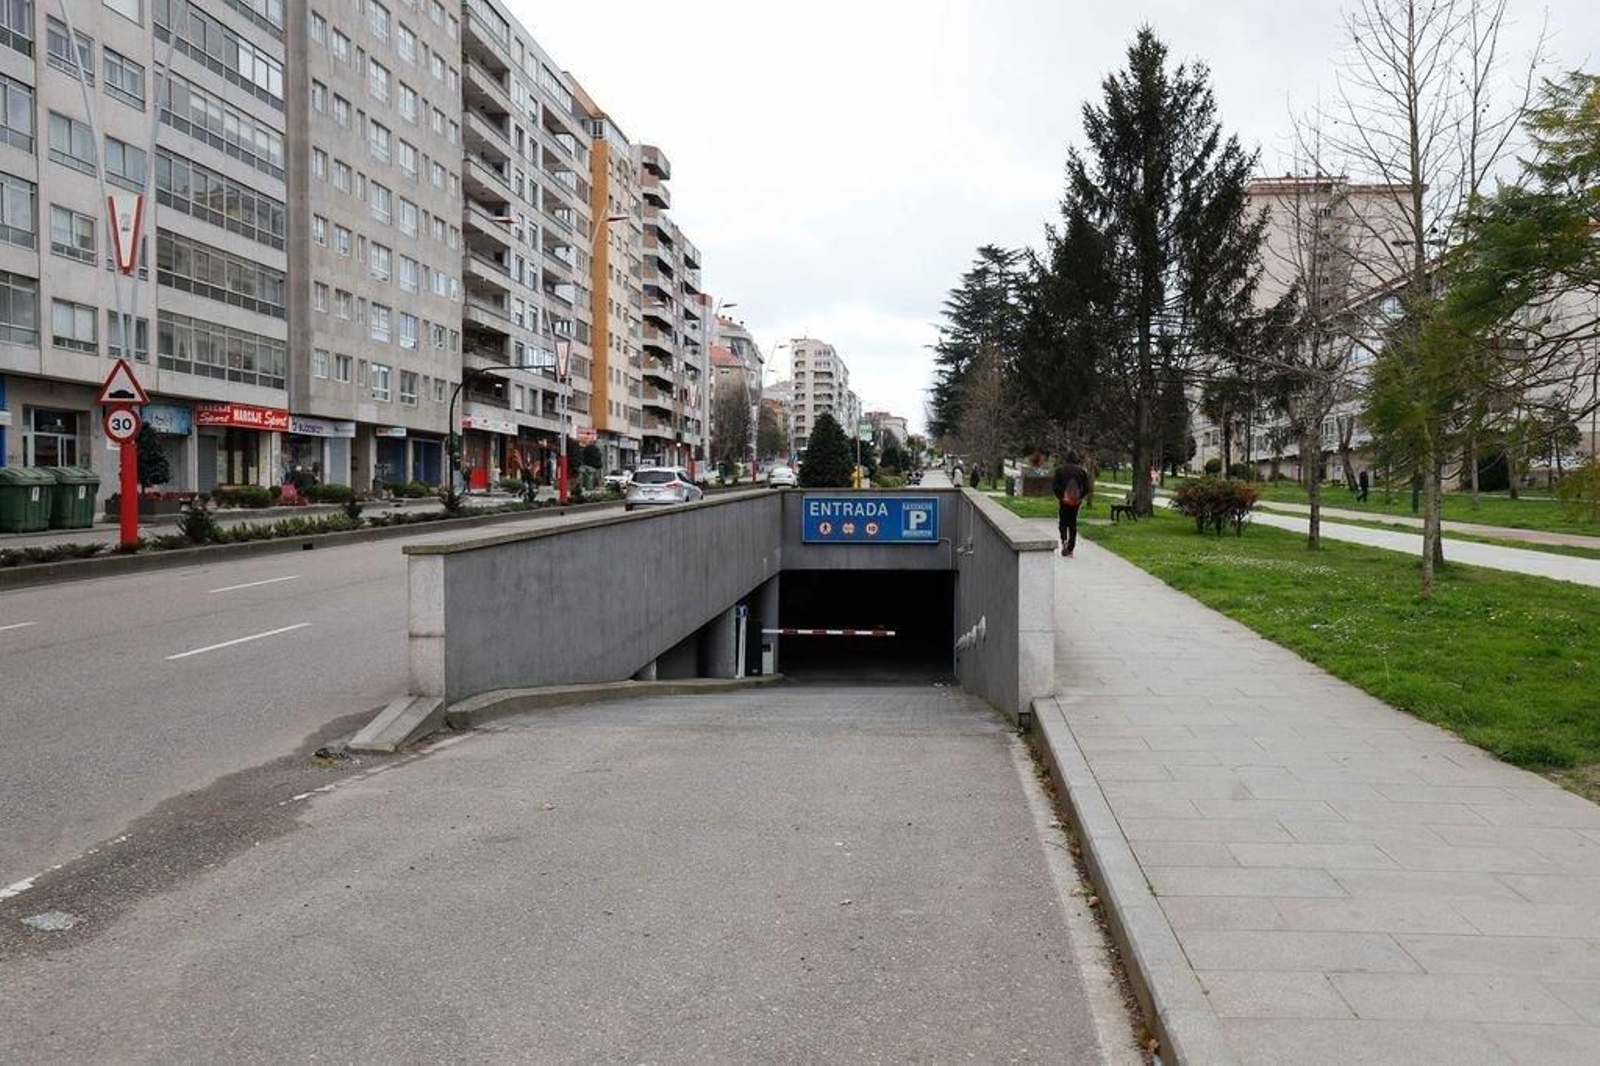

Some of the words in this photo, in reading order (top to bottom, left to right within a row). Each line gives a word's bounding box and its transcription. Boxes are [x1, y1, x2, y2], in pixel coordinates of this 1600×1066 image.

[112, 418, 132, 430] 30
[199, 412, 230, 424] Sport
[263, 410, 288, 428] Sport
[809, 502, 888, 517] ENTRADA
[909, 510, 927, 530] P
